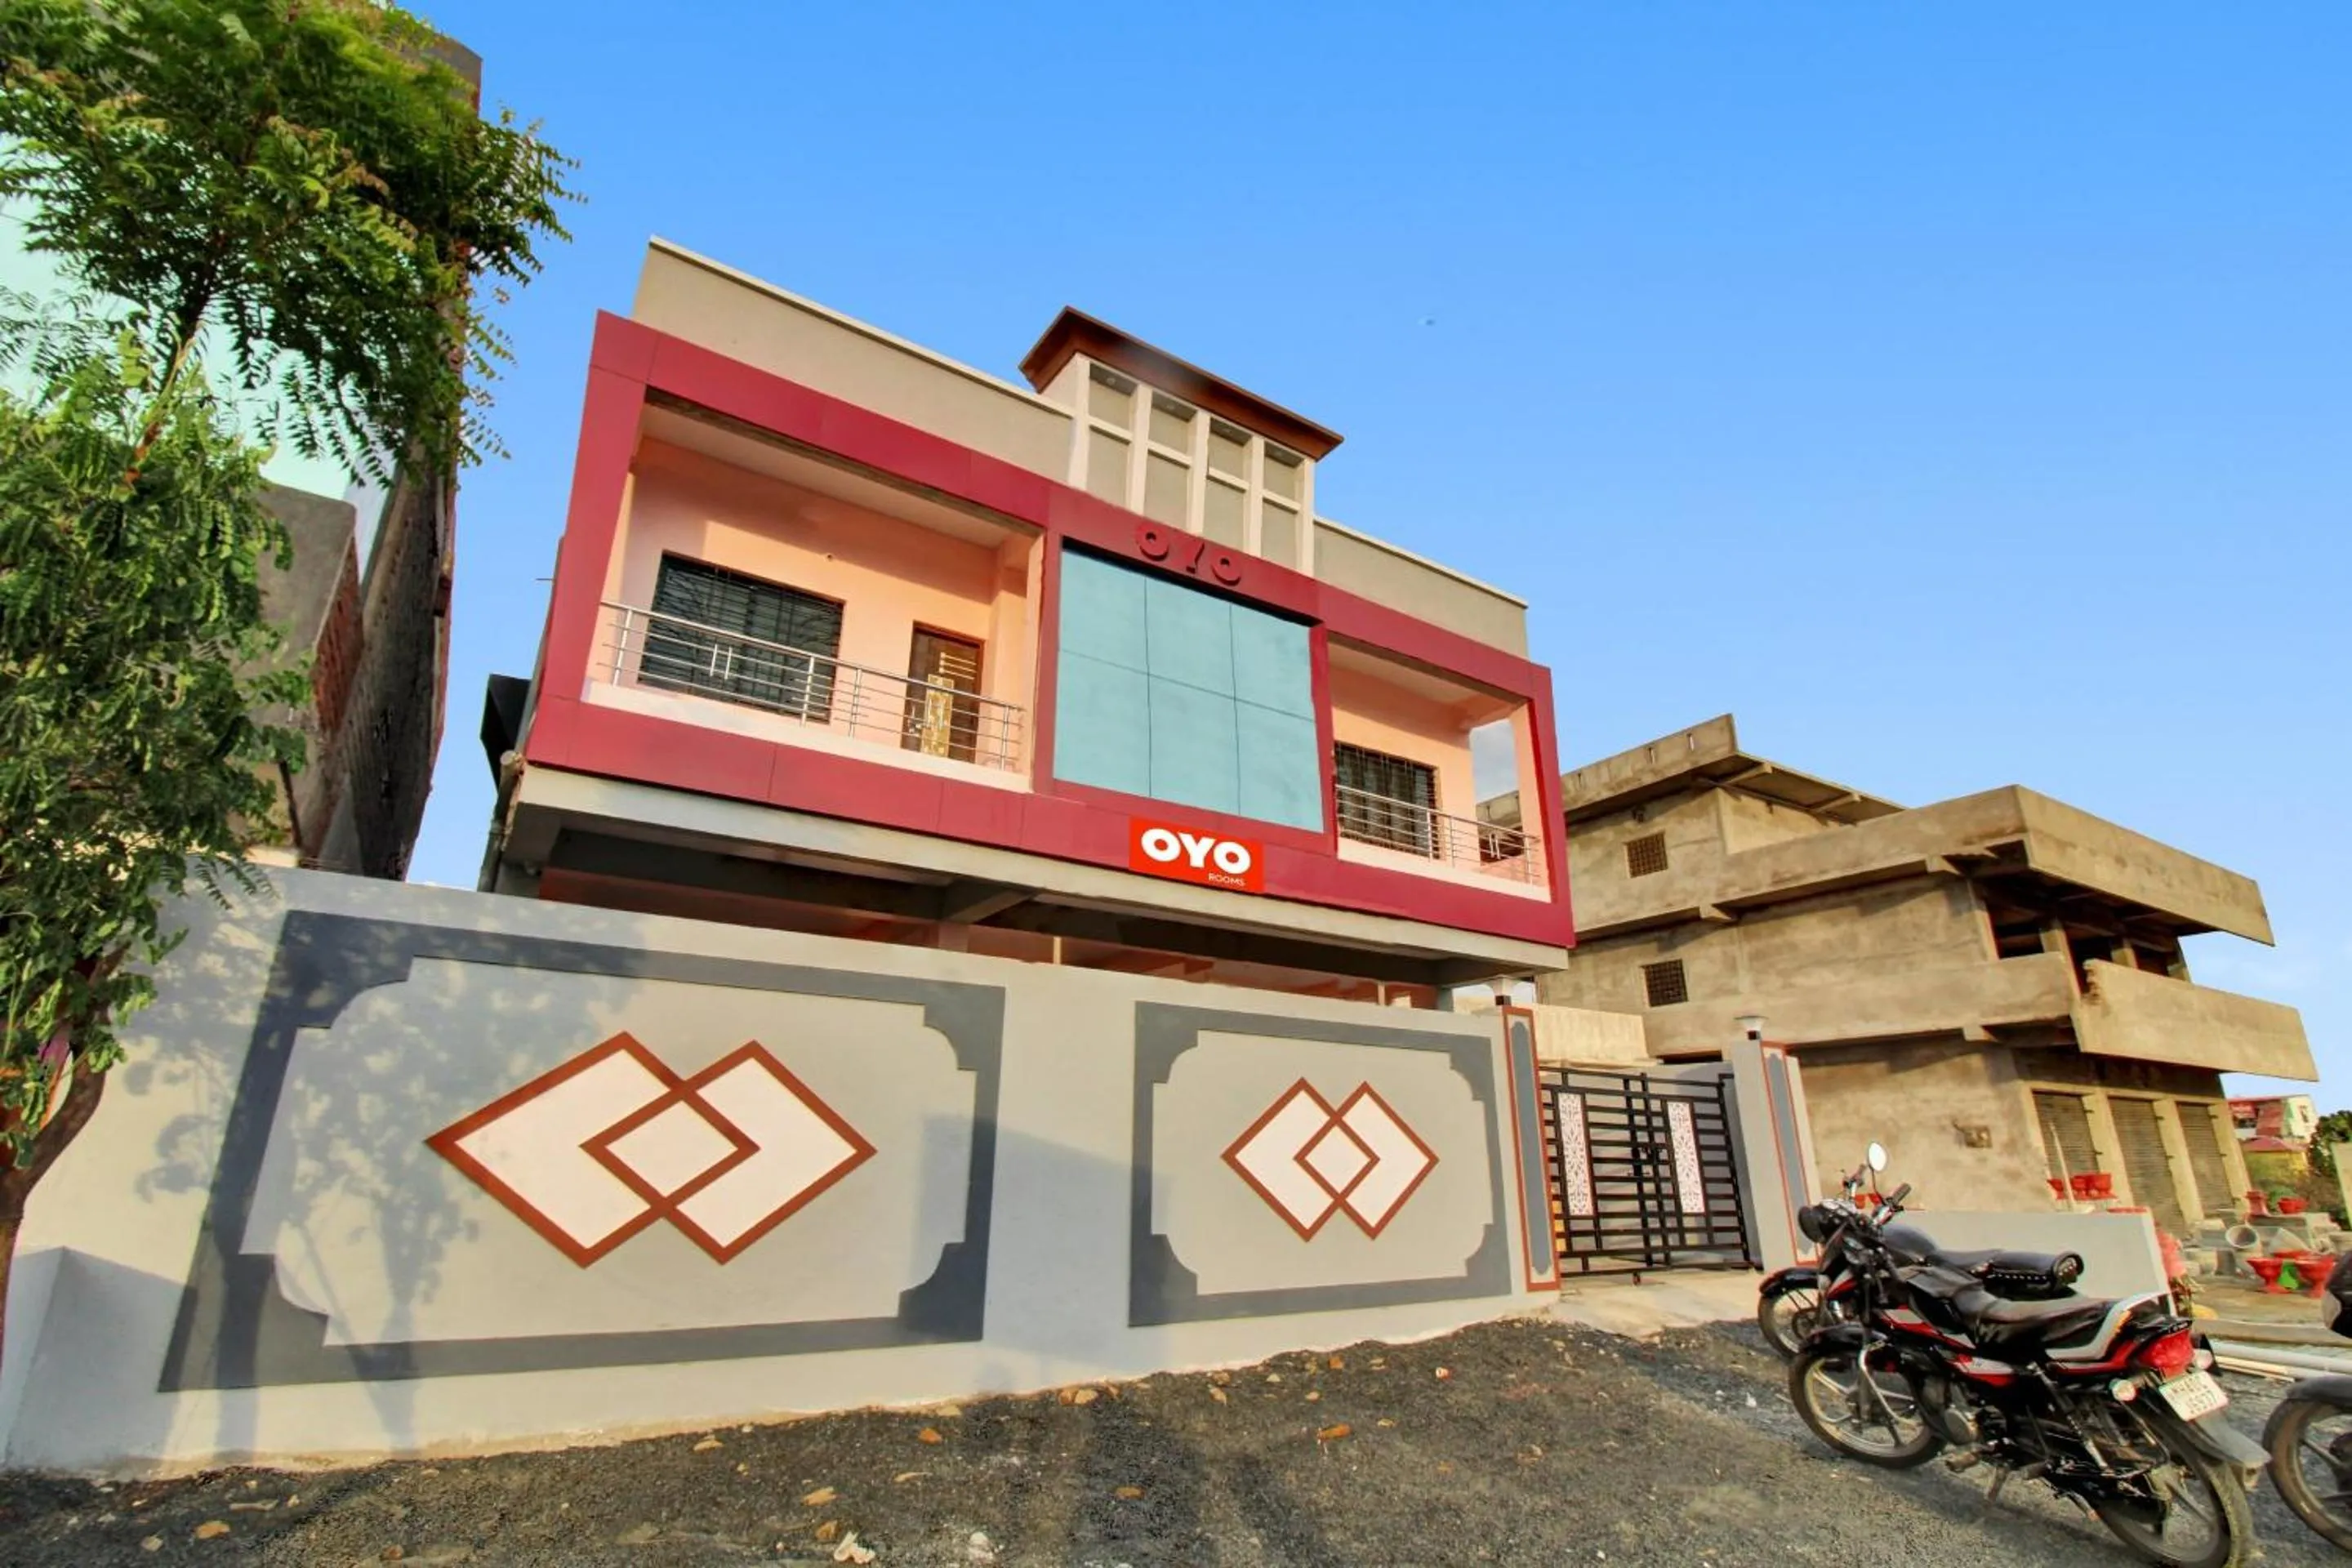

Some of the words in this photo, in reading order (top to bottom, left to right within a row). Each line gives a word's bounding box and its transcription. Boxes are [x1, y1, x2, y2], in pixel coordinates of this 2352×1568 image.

[1136, 521, 1241, 586] OYO
[1141, 828, 1251, 873] OYO
[1209, 873, 1245, 887] ROOMS
